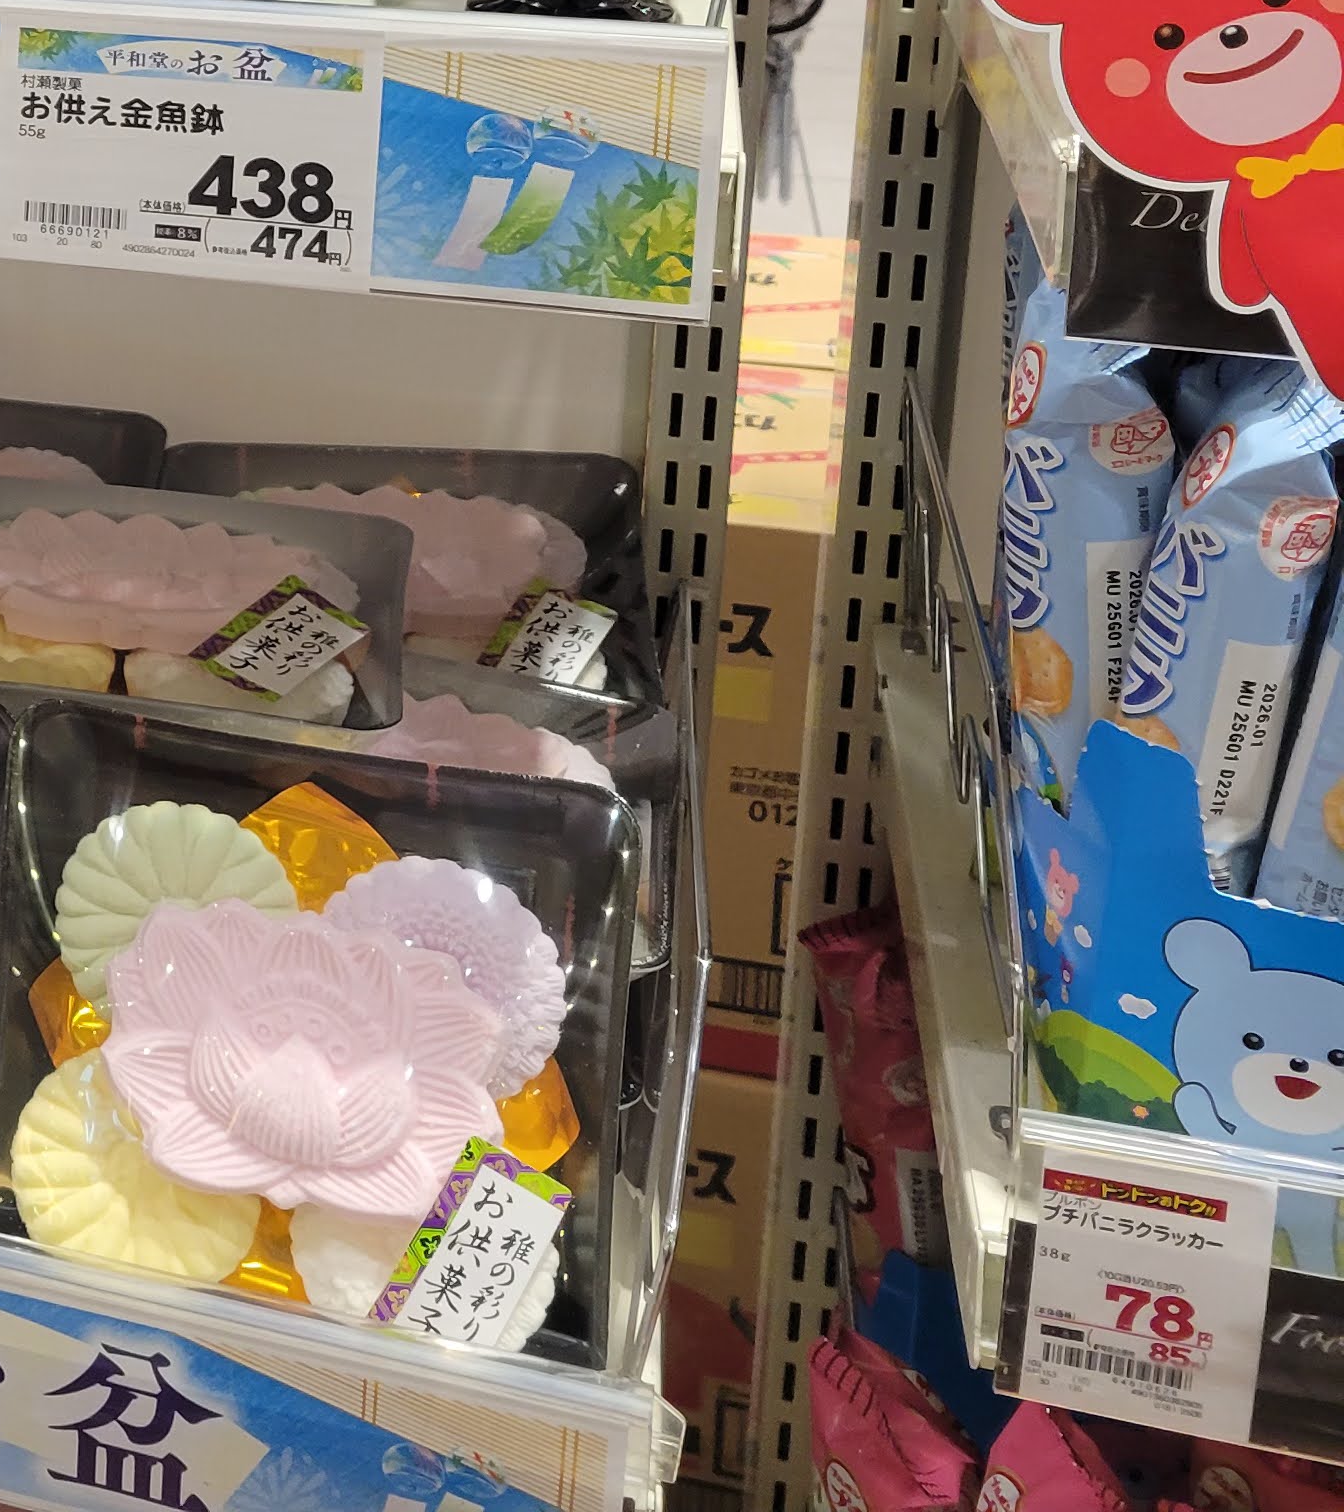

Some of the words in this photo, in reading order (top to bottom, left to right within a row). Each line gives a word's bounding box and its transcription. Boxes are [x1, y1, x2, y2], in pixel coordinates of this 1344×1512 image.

[20, 74, 82, 92] 村瀬製菓
[105, 47, 274, 83] 平和堂のお盆
[18, 123, 46, 140] 55g
[20, 91, 224, 135] お供え金魚鉢
[40, 222, 110, 240] 66690121
[229, 604, 323, 674] お供菓子
[1250, 682, 1278, 749] 2026.01
[1043, 1205, 1224, 1250] プチバニラクラッカー
[408, 1180, 514, 1335] お供菓子
